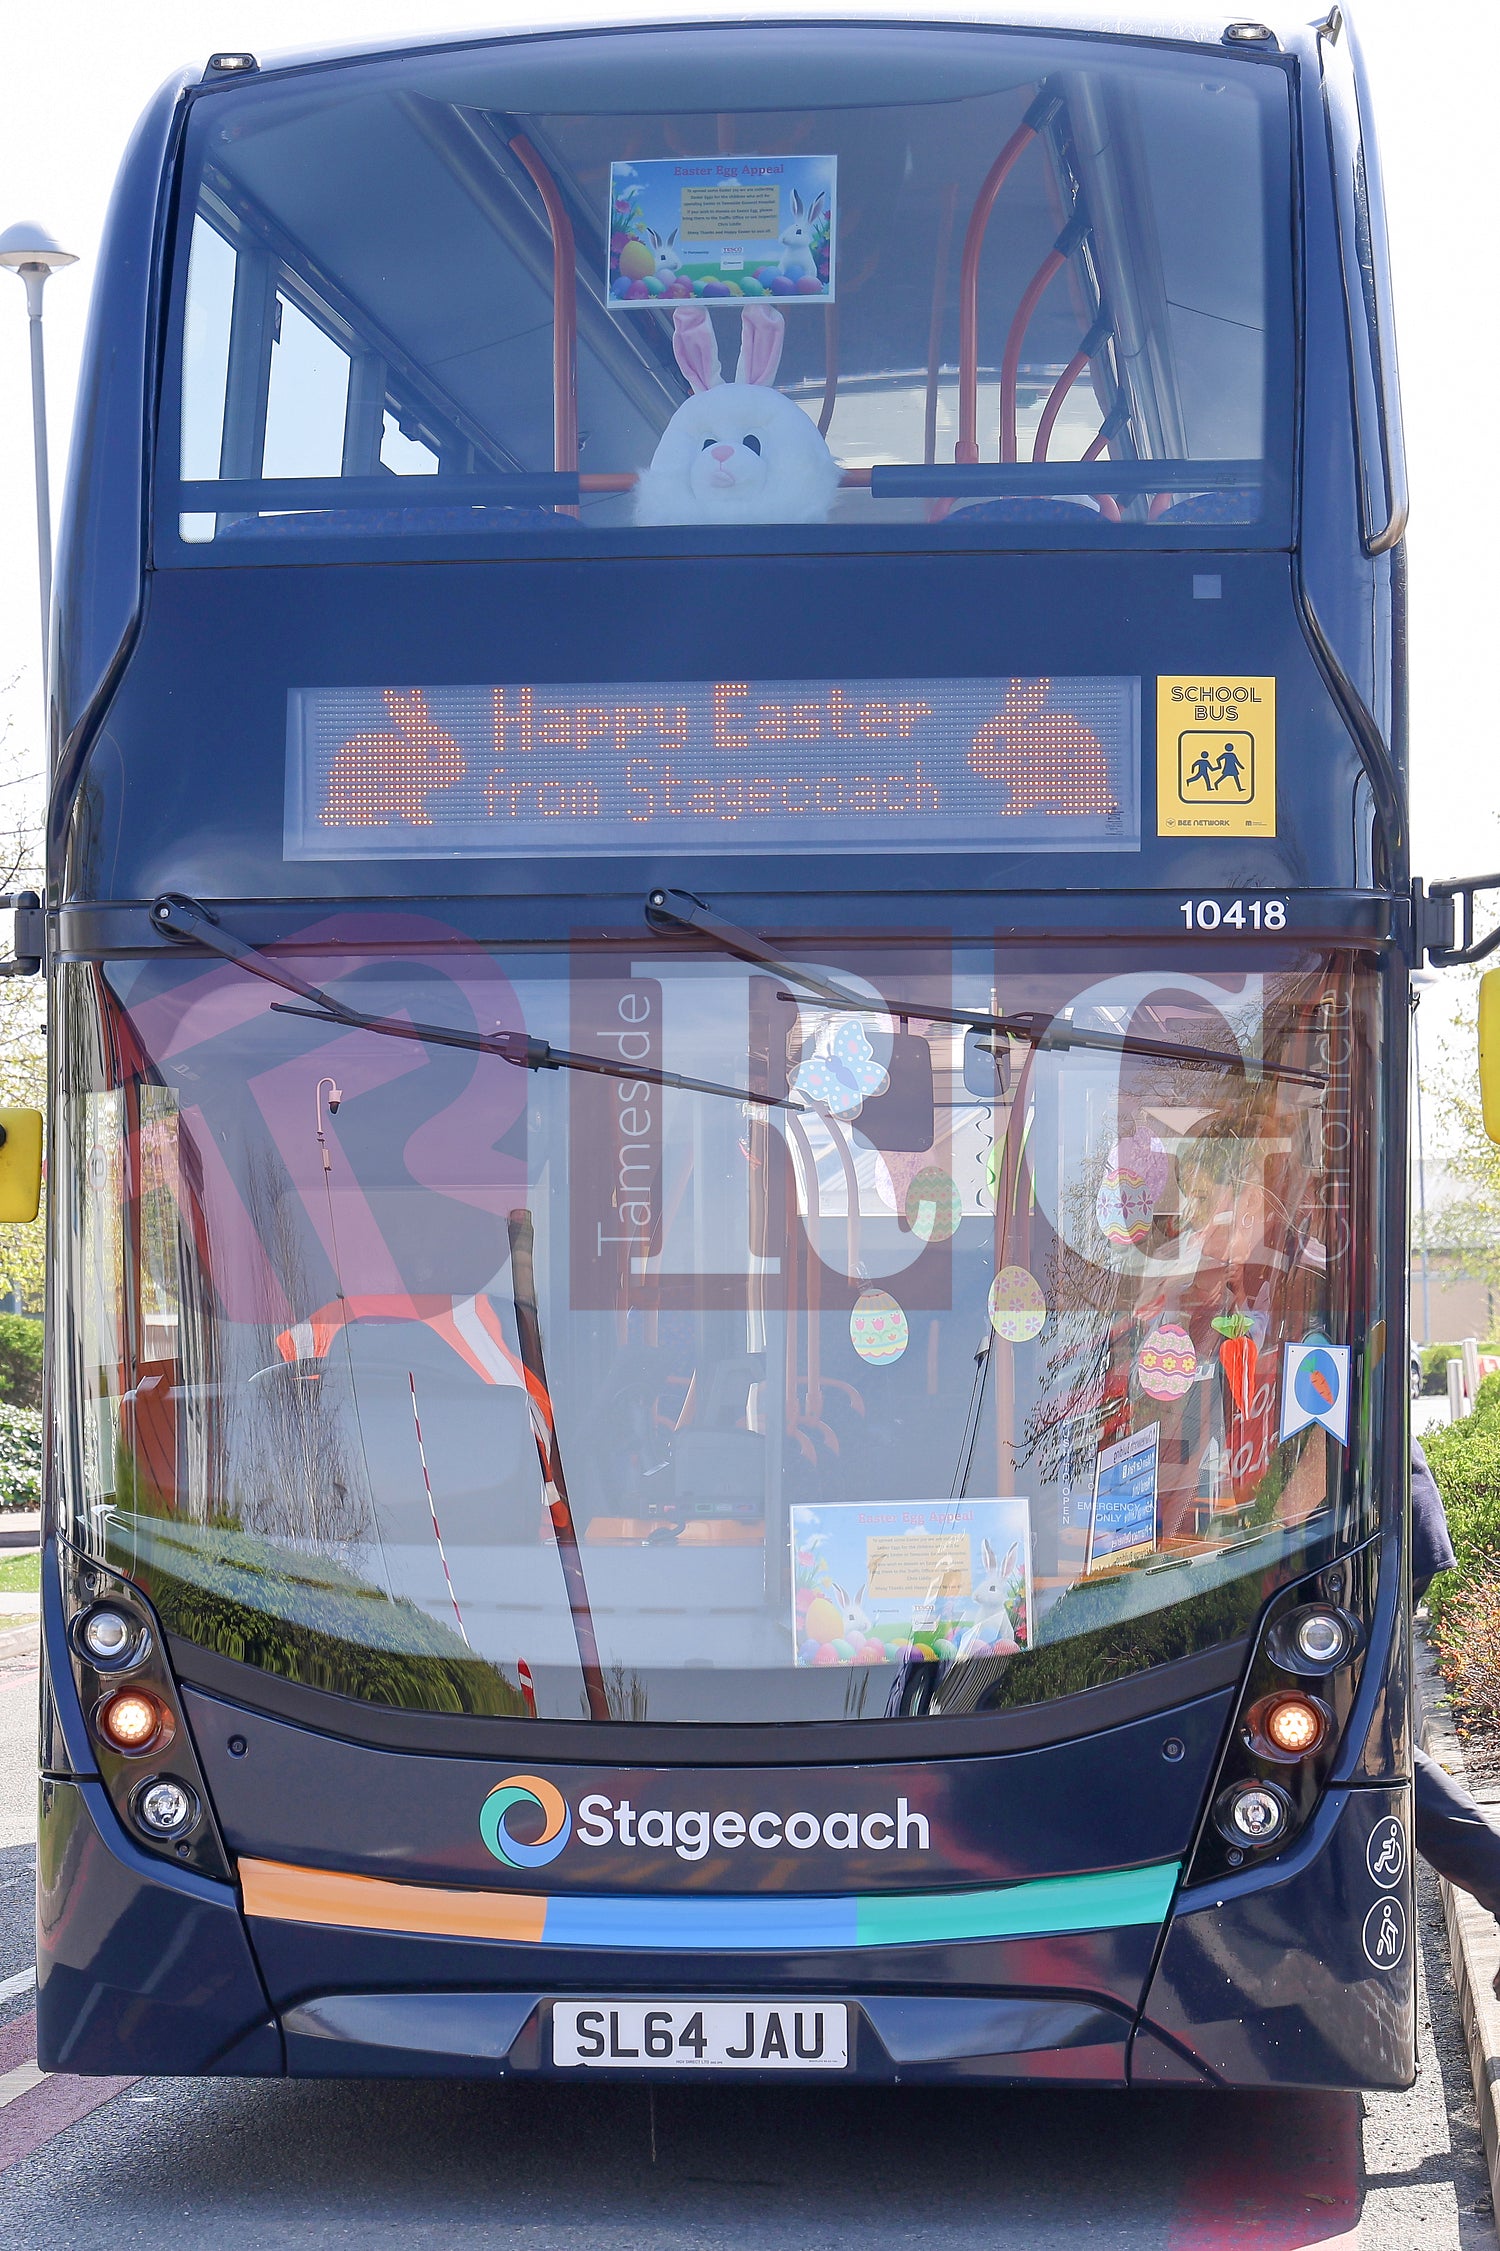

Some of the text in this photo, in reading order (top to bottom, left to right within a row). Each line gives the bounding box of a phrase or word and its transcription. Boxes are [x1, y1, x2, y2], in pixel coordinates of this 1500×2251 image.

[674, 164, 784, 178] Easter Egg Appeal
[1171, 686, 1262, 703] SCHOOL
[493, 684, 933, 750] Happy Easter
[1194, 705, 1239, 722] BUS
[483, 757, 939, 821] from Stagecoach
[1180, 900, 1287, 930] 10418
[858, 1510, 975, 1526] Easter Egg Appeal
[1062, 1487, 1070, 1525] OPEN
[1096, 1513, 1122, 1523] ONLY
[576, 1794, 931, 1860] Stagecoach
[576, 2011, 824, 2059] SL64 JAU
